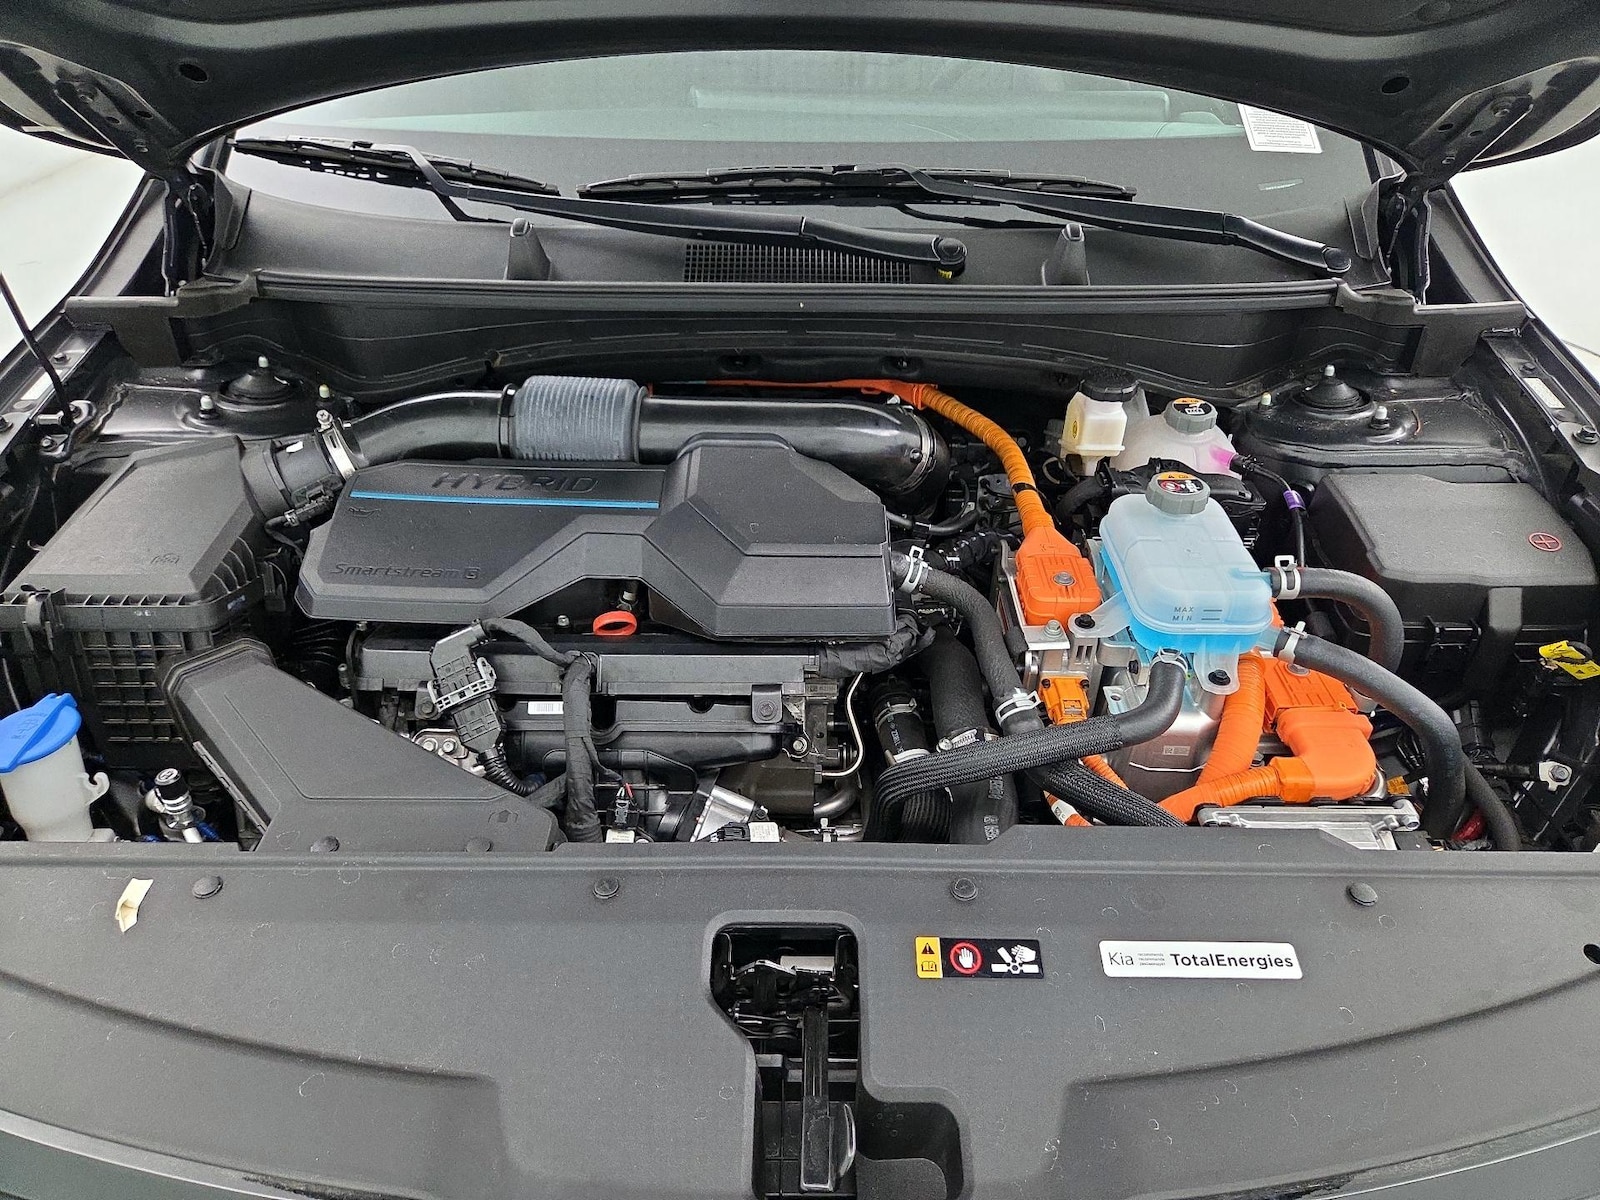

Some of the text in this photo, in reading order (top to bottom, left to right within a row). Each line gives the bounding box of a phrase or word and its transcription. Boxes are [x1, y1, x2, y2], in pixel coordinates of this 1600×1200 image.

[431, 472, 599, 494] HYBRID
[330, 562, 460, 578] Smartstream
[1108, 952, 1294, 970] Kia TotalEnergies
